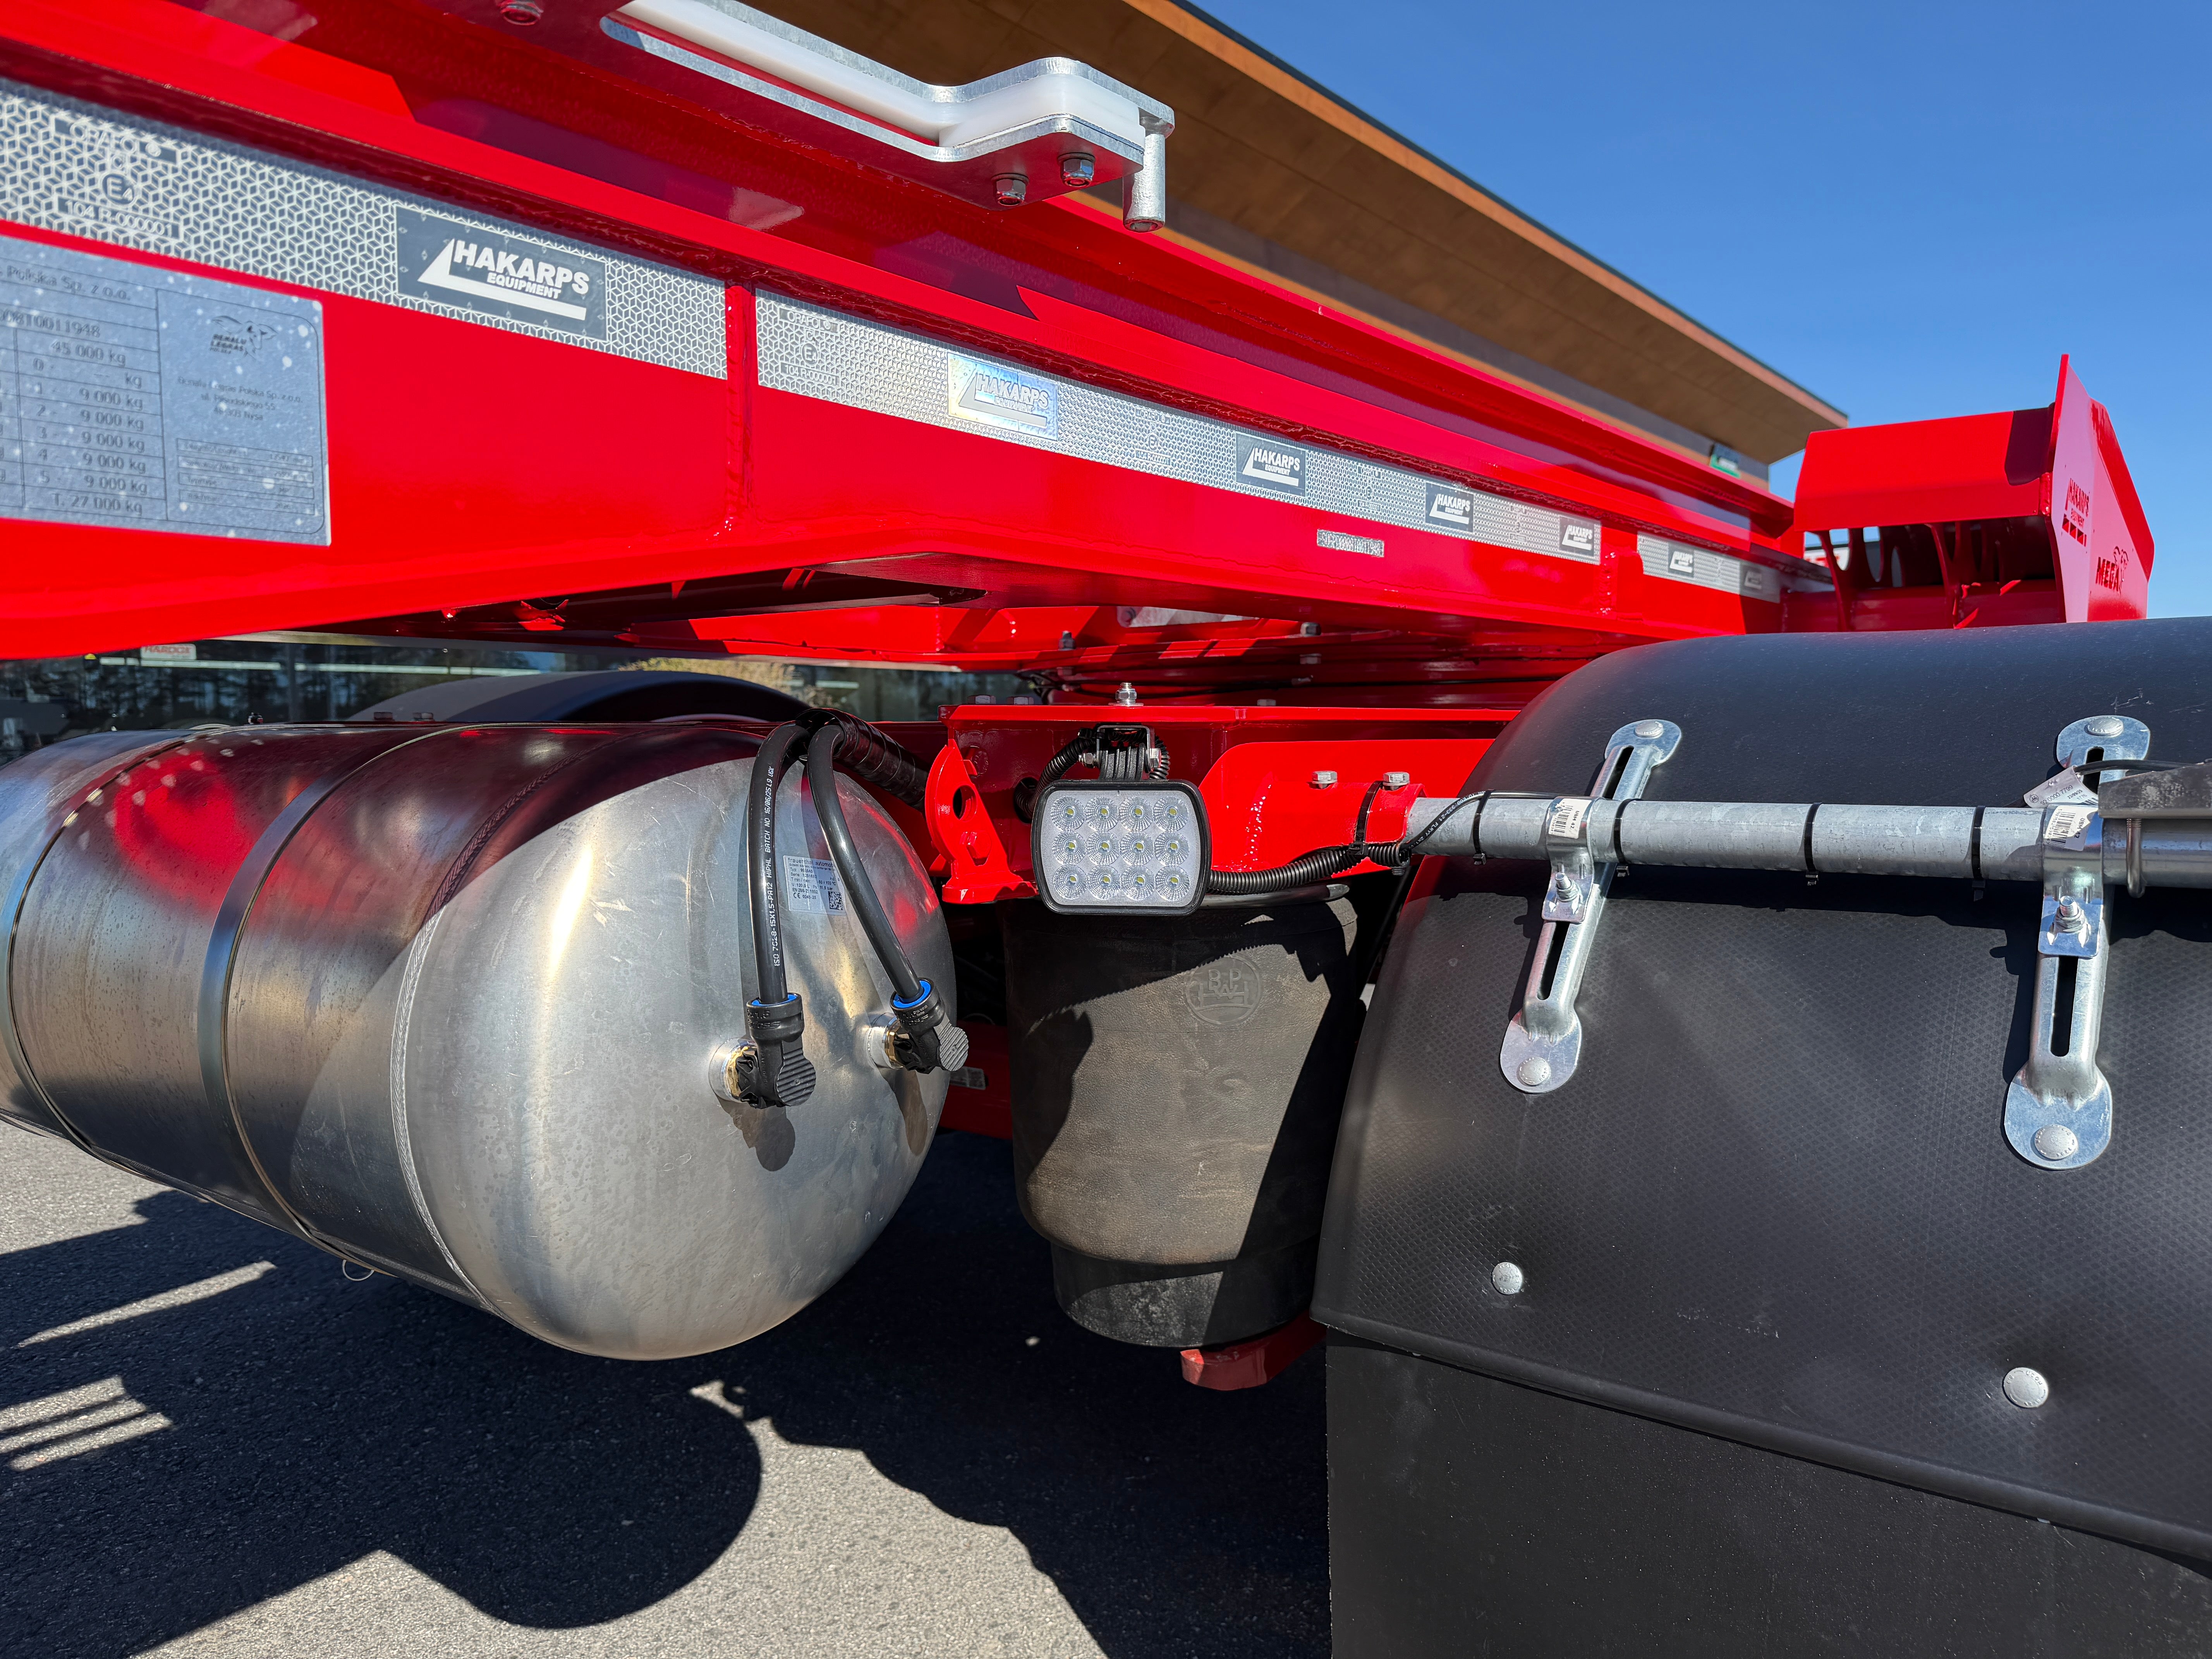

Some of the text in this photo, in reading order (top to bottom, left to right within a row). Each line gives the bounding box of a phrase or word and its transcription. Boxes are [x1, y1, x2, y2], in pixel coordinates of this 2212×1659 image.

[453, 240, 589, 294] HAKARPS
[487, 272, 562, 299] EQUIPMENT
[76, 344, 104, 360] 000
[109, 350, 126, 367] kg
[124, 372, 142, 388] kg
[785, 365, 799, 376] 104
[79, 388, 89, 400] 9
[94, 390, 121, 405] 000
[126, 394, 143, 411] kg
[977, 374, 1049, 409] HAKARPS
[81, 409, 90, 422] 9
[96, 412, 122, 426] 000
[127, 416, 144, 432] kg
[81, 431, 92, 444] 9
[96, 433, 123, 448] 000
[128, 437, 145, 453] kg
[82, 452, 93, 465] 9
[98, 454, 124, 469] 000
[129, 458, 146, 474] kg
[1254, 447, 1300, 471] HAKARPS
[1265, 464, 1290, 476] EQUIPMENT
[84, 475, 94, 488] 9
[99, 477, 126, 491] 000
[131, 480, 147, 495] kg
[93, 496, 121, 510] 000
[125, 500, 143, 517] kg
[1438, 493, 1470, 512] HAKARPS
[1568, 525, 1593, 540] HAKARPS
